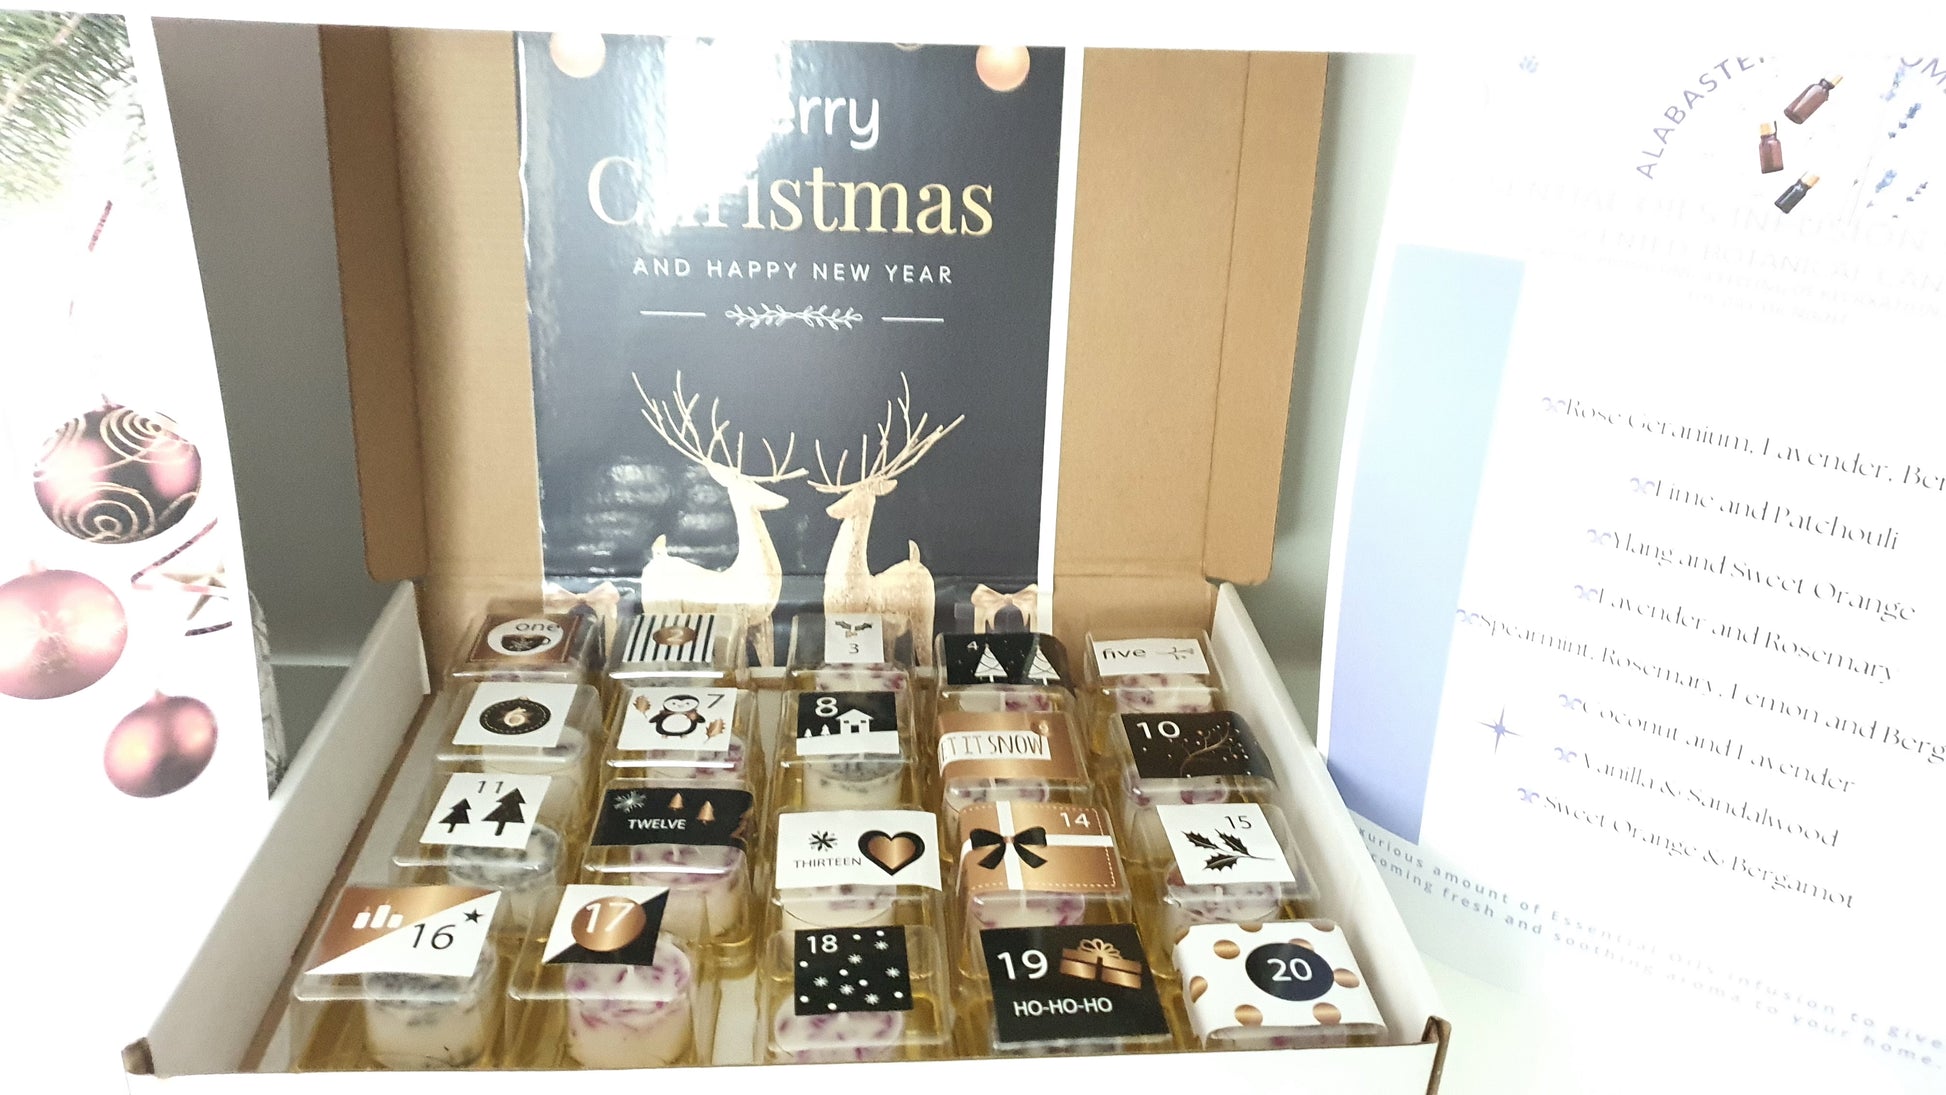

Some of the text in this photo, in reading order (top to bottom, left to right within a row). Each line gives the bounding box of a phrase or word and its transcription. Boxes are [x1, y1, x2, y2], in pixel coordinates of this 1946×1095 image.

[1636, 56, 1765, 180] ALABASTE
[632, 257, 952, 284] AND HAPPY NEW YEAR
[1566, 398, 1622, 425] Rose
[1655, 479, 1898, 550] Lime and Patchouli
[1614, 531, 1916, 623] Ylang and Sweet Orange
[515, 621, 560, 632] one
[666, 628, 685, 643] 2
[1598, 587, 1891, 684] Lavender and Rosemary
[849, 643, 859, 654] 3
[967, 640, 980, 651] 4
[1102, 648, 1147, 660] five
[707, 693, 726, 709] 7
[815, 696, 838, 717] 8
[1731, 683, 1819, 724] Lemon
[1825, 716, 1878, 740] and
[503, 706, 528, 728] 6
[1136, 720, 1181, 740] 10
[962, 735, 983, 756] IT
[988, 734, 1043, 756] SNOW
[1582, 702, 1858, 793] Coconut and Lavender
[477, 780, 504, 794] 11
[1584, 752, 1654, 790] Vanilla
[1689, 789, 1839, 848] Sandalwood
[628, 818, 687, 831] TWELVE
[1060, 811, 1092, 829] 14
[1224, 814, 1253, 830] 15
[794, 856, 863, 869] THIRTEEN
[1545, 796, 1605, 828] Sweet
[1613, 820, 1697, 857] Orange
[1731, 855, 1853, 909] Bergamot
[585, 902, 635, 934] 17
[1443, 887, 1494, 918] fresh
[1504, 913, 1543, 935] and
[411, 922, 456, 951] 16
[806, 934, 839, 954] 18
[997, 948, 1049, 980] 19
[1432, 866, 1509, 905] amount
[1519, 899, 1541, 916] of
[1848, 1011, 1876, 1028] to
[1886, 1024, 1945, 1051] give
[1266, 957, 1313, 983] 20
[1013, 997, 1114, 1018] HO-HO-HO
